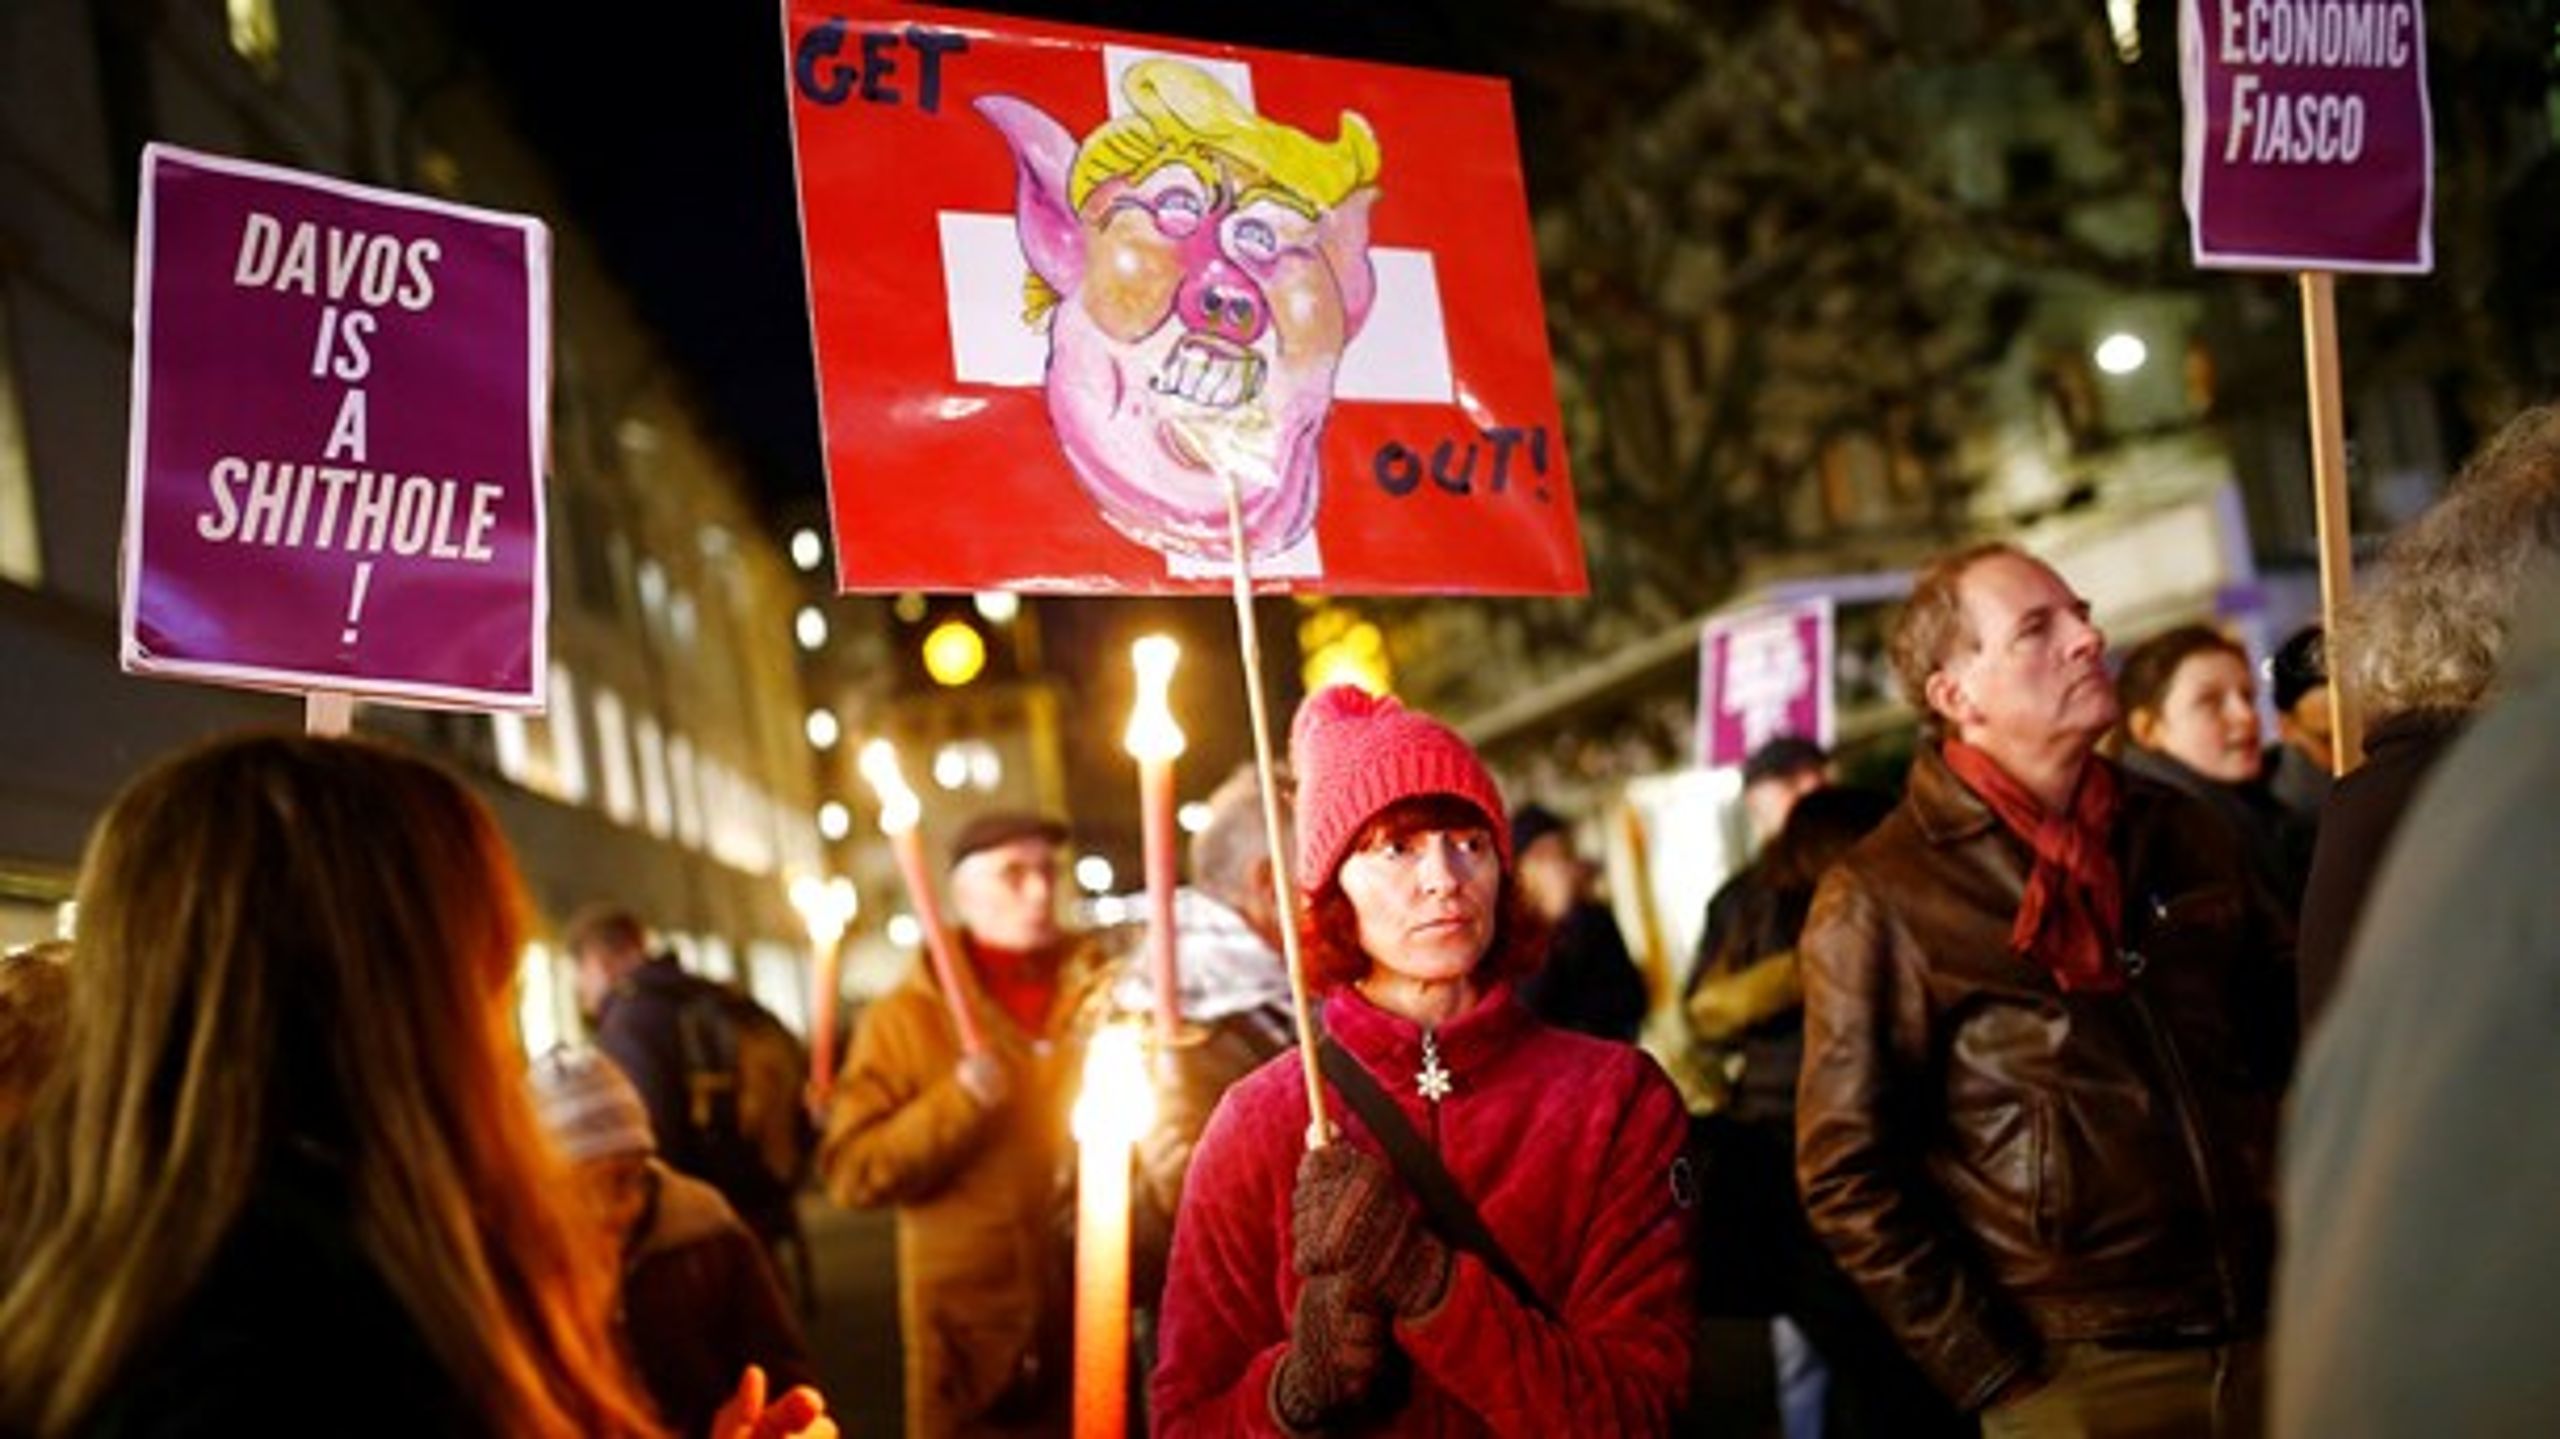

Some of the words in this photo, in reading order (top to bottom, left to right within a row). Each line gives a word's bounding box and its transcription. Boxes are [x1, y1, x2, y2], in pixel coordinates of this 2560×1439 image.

[796, 17, 968, 113] GET
[2220, 0, 2410, 67] ECONOMIC
[235, 213, 440, 310] DAVOS
[312, 306, 377, 382] IS
[324, 389, 367, 462] A
[1374, 427, 1550, 502] OUT!
[198, 457, 503, 561] SHITHOLE
[341, 563, 373, 645] !
